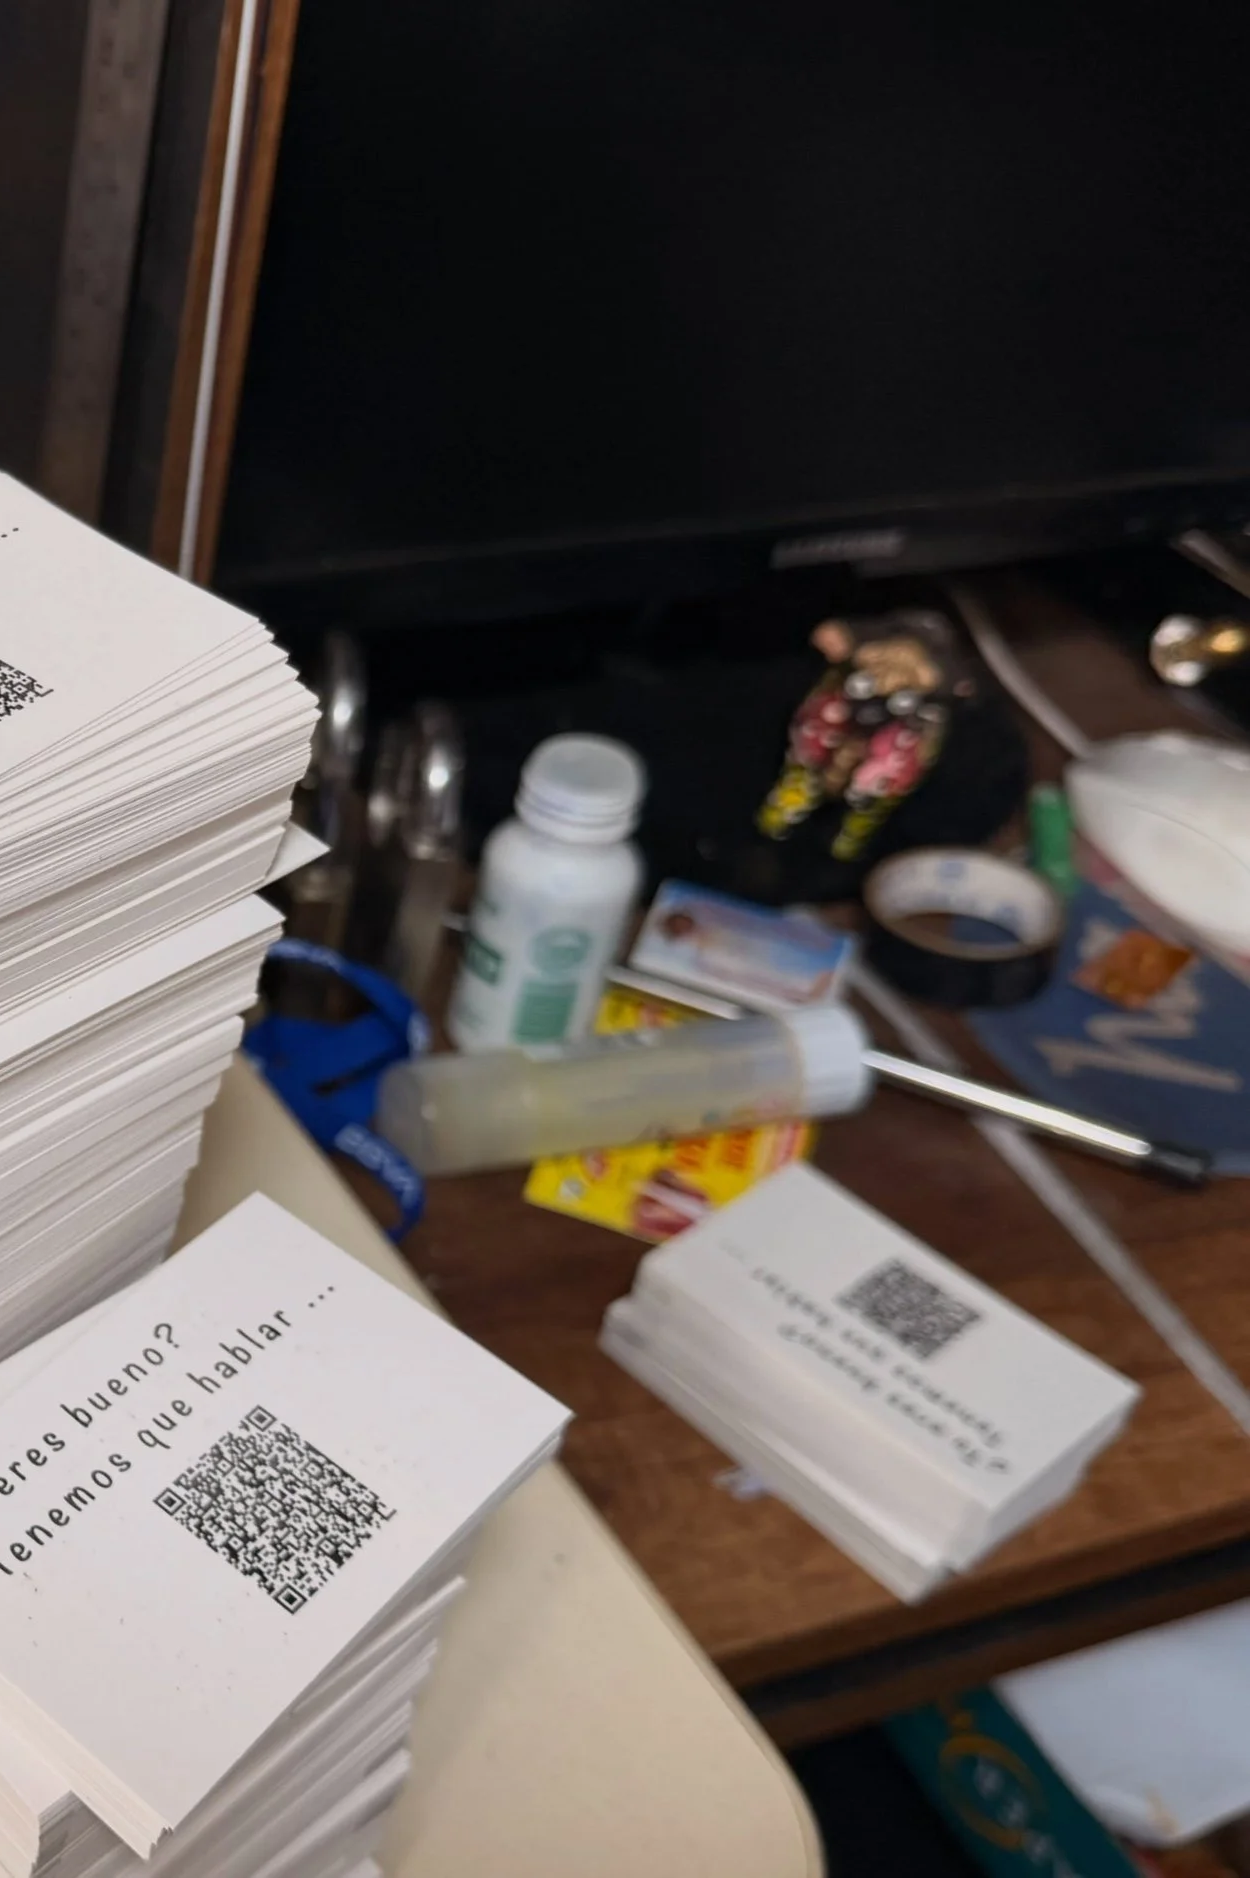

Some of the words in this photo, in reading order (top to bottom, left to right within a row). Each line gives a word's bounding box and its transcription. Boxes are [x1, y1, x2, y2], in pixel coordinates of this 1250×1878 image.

[60, 1322, 180, 1428] bueno?
[136, 1399, 193, 1450] que
[186, 1309, 292, 1394] hablar
